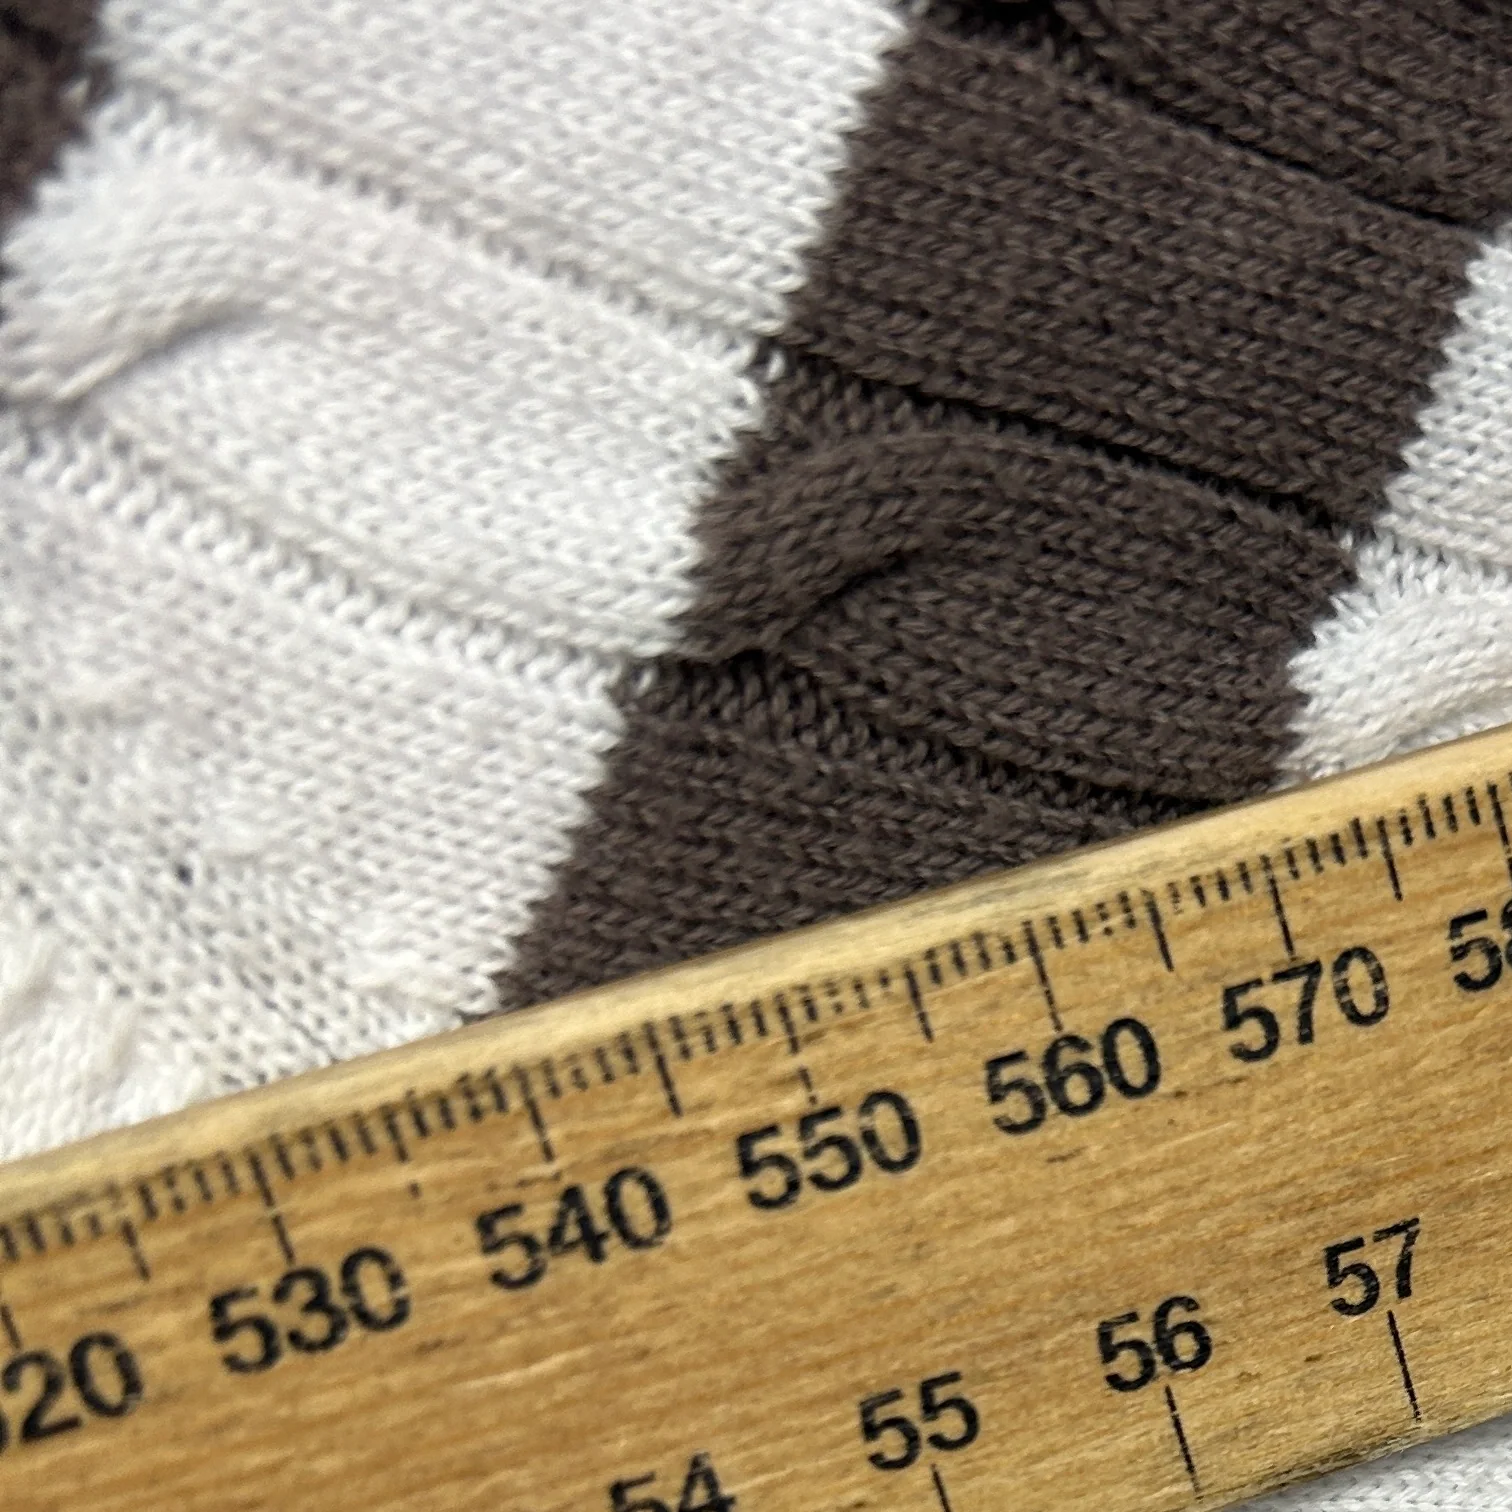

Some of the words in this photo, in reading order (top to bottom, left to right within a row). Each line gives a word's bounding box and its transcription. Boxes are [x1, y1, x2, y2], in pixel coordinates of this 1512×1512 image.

[0, 1332, 144, 1454] 20
[209, 1246, 410, 1374] 530
[475, 1166, 672, 1291] 540
[735, 1089, 921, 1210] 550
[984, 1017, 1161, 1135] 560
[1222, 945, 1389, 1063] 570
[859, 1372, 980, 1471] 55
[1096, 1296, 1213, 1392] 56
[1322, 1217, 1420, 1316] 57
